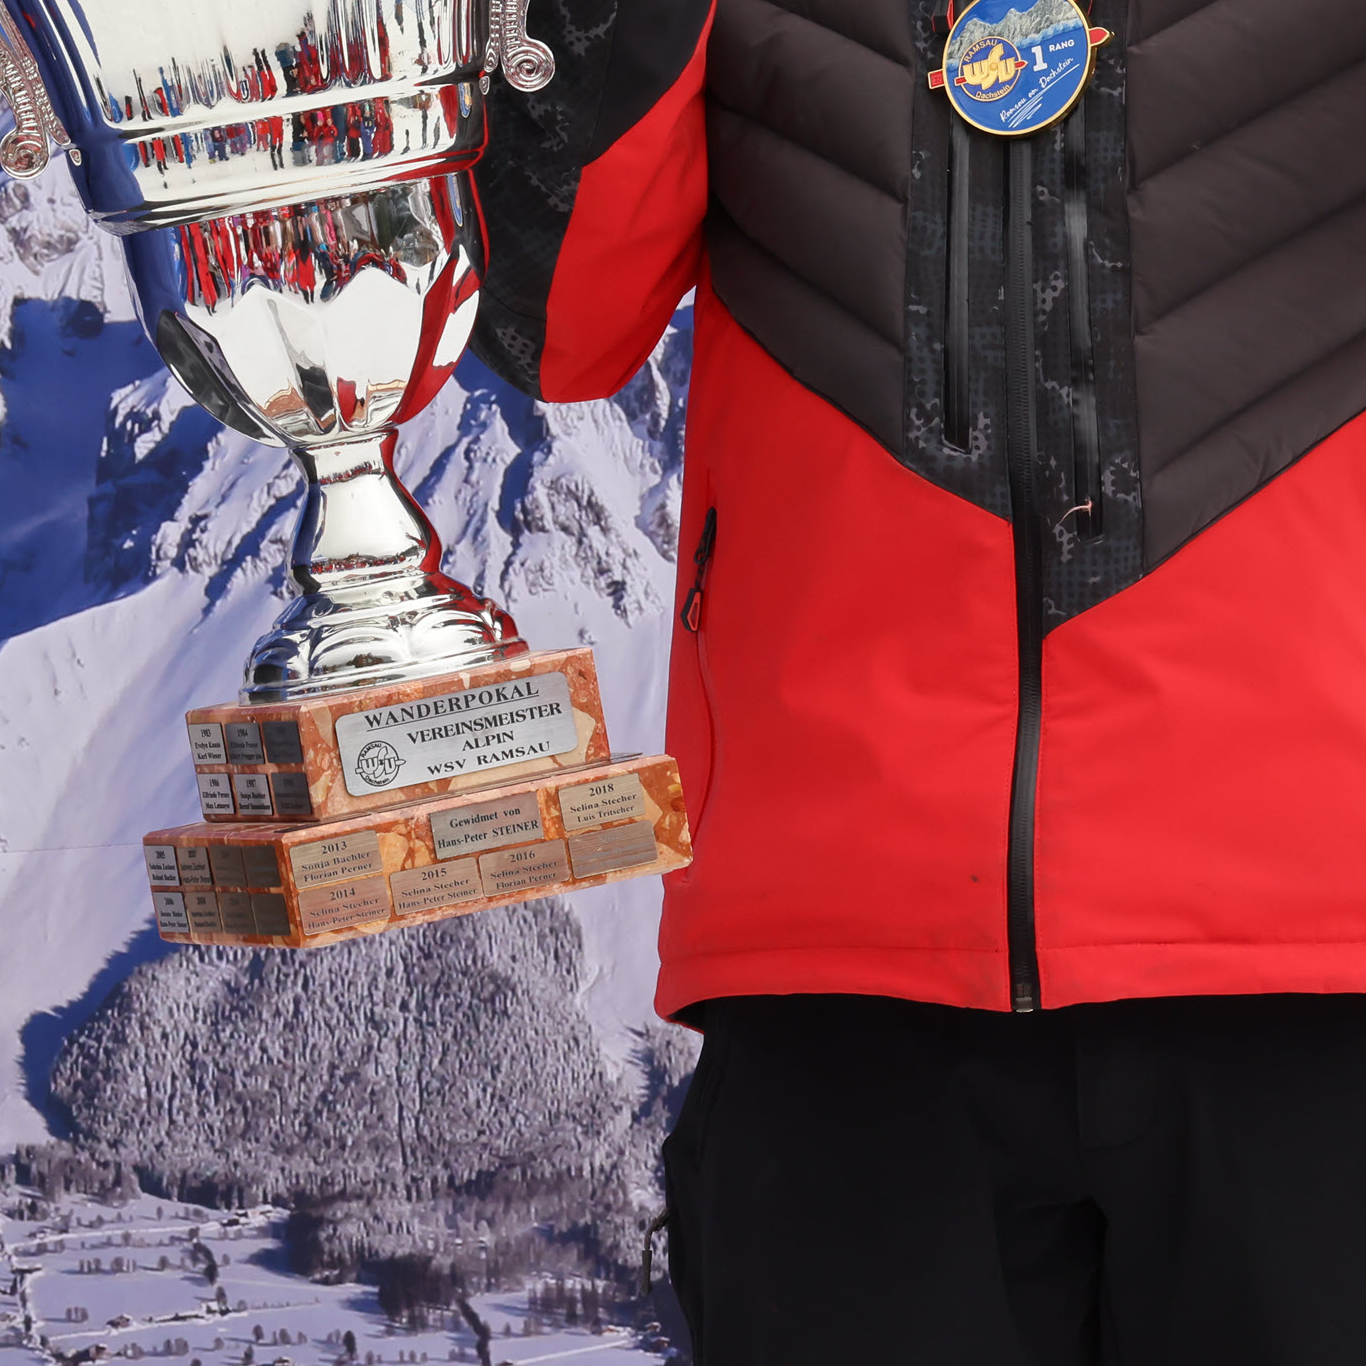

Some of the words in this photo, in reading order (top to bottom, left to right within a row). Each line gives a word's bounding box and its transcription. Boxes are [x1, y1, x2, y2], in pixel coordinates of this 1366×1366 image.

[964, 39, 998, 63] RAMSAU
[1031, 45, 1048, 72] 1
[1049, 39, 1075, 52] RANG
[976, 84, 1010, 99] Dachstein
[364, 682, 539, 730] WANDERPOKAL
[406, 702, 563, 745] VEREINSMEISTER
[462, 730, 515, 751] ALPIN
[427, 758, 467, 776] WSV
[477, 741, 551, 766] RAMSAU
[589, 783, 615, 797] 2018
[570, 803, 599, 814] Selina
[601, 794, 637, 807] Stecher
[577, 813, 596, 823] Luis
[598, 805, 635, 818] Tritscher
[449, 811, 498, 829] Gewidmet
[503, 807, 521, 818] von
[437, 832, 488, 849] Hans-Peter
[492, 819, 539, 838] STEINER
[321, 840, 347, 855] 2013
[509, 849, 535, 863] 2016
[301, 861, 331, 872] Sonja
[333, 851, 371, 865] Bachler
[490, 868, 520, 880] Selina
[522, 860, 557, 873] Stecher
[304, 870, 338, 883] Florian
[340, 862, 373, 875] Perner
[421, 868, 447, 881] 2015
[496, 878, 526, 890] Florian
[528, 871, 557, 883] Perner
[330, 887, 356, 901] 2014
[401, 887, 432, 898] Selina
[433, 878, 470, 891] Stecher
[309, 906, 340, 917] Selina
[342, 897, 380, 910] Stecher
[398, 895, 445, 910] Hans-Peter
[447, 887, 477, 900] Steiner
[307, 915, 354, 930] Hans-Peter
[356, 907, 385, 919] Steiner
